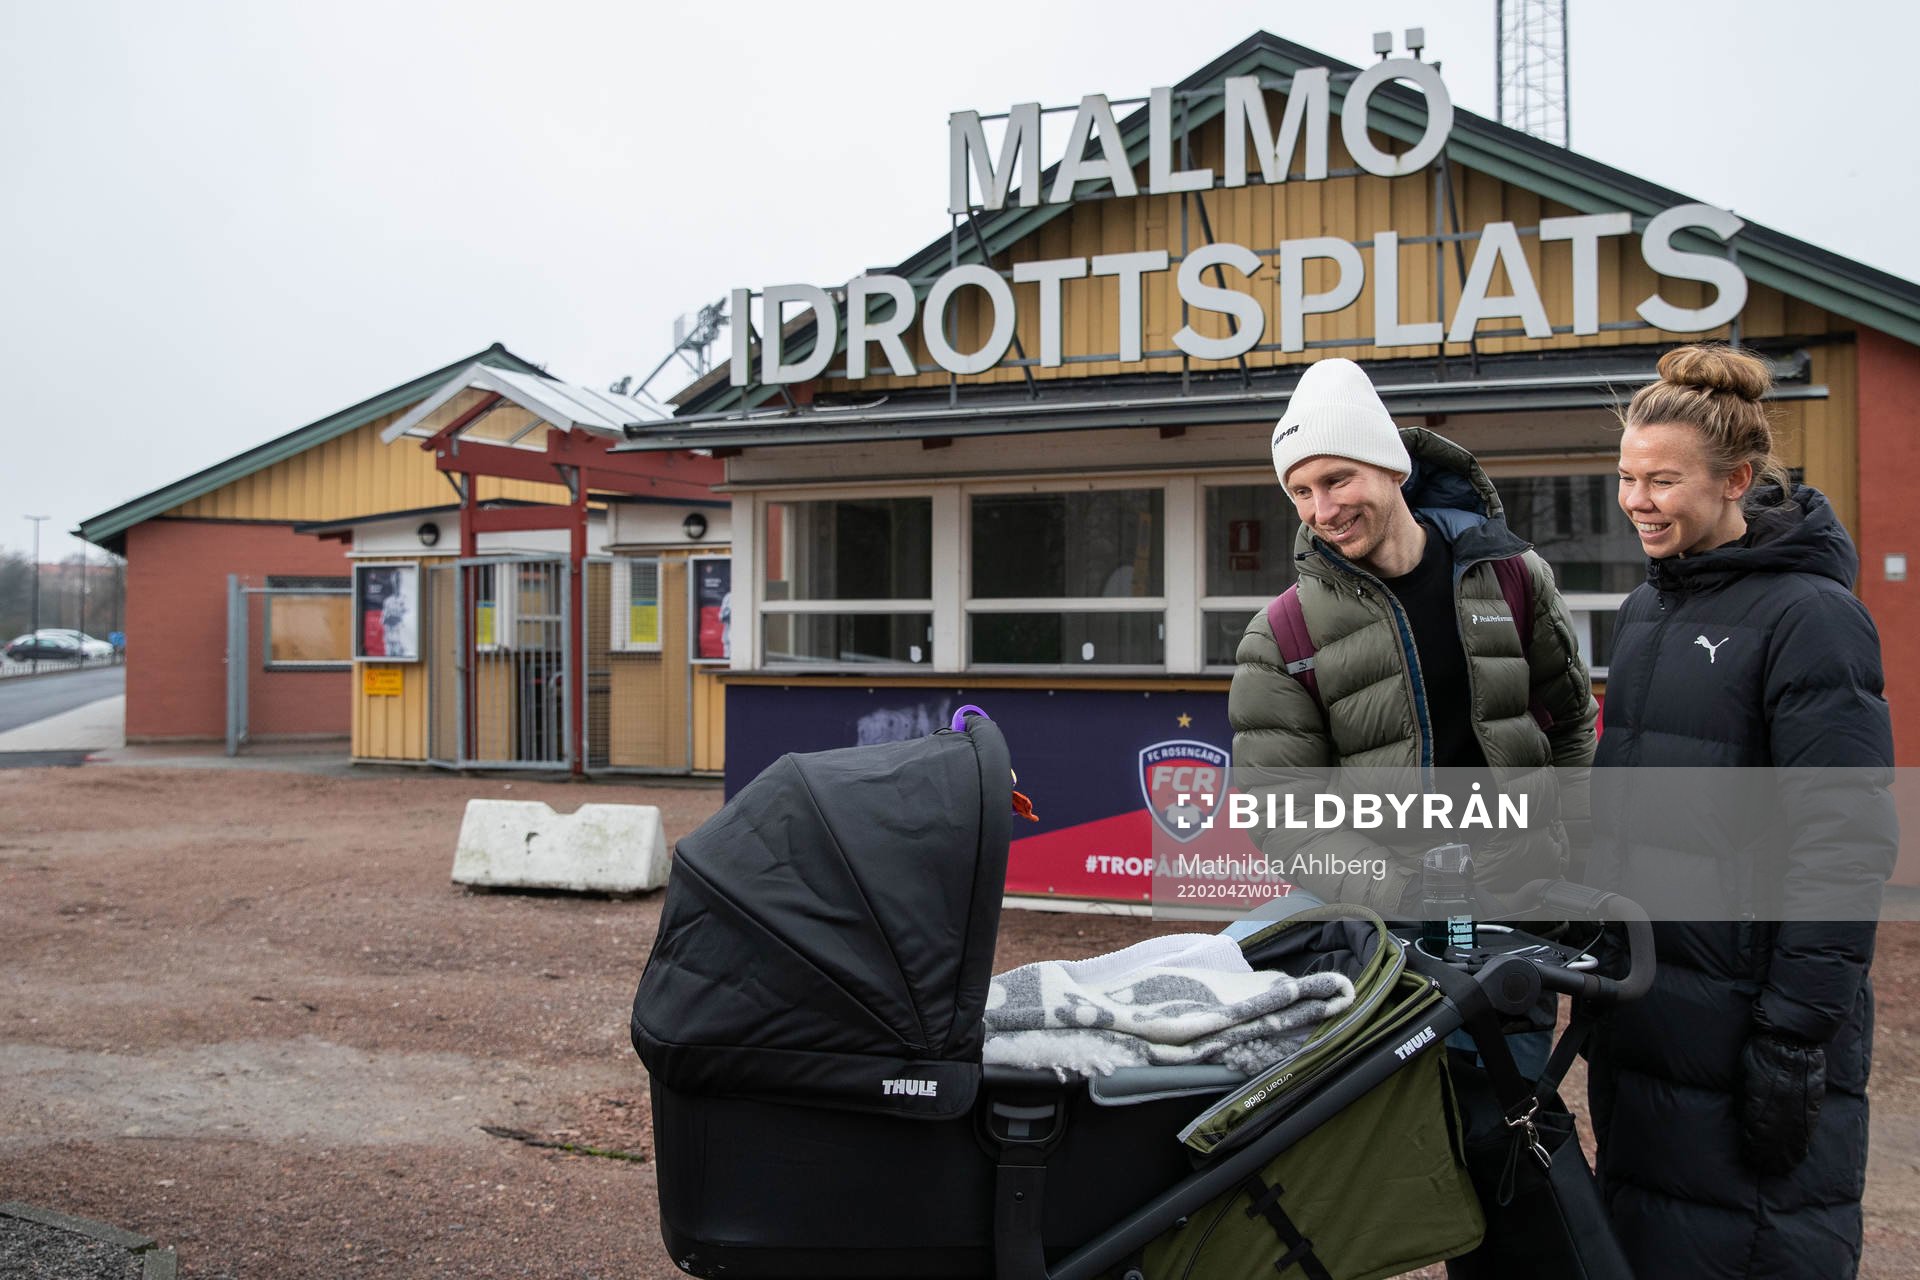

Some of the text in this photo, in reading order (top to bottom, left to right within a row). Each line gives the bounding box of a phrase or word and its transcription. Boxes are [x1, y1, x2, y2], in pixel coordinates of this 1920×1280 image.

[950, 27, 1454, 213] MALMÖ
[730, 203, 1748, 387] IDROTTSPLATS
[1147, 746, 1222, 764] FC ROSENGÅRD
[1152, 766, 1217, 793] FCR
[1394, 1025, 1436, 1060] THULE
[882, 1079, 938, 1096] THULE
[1243, 1090, 1267, 1108] Glide
